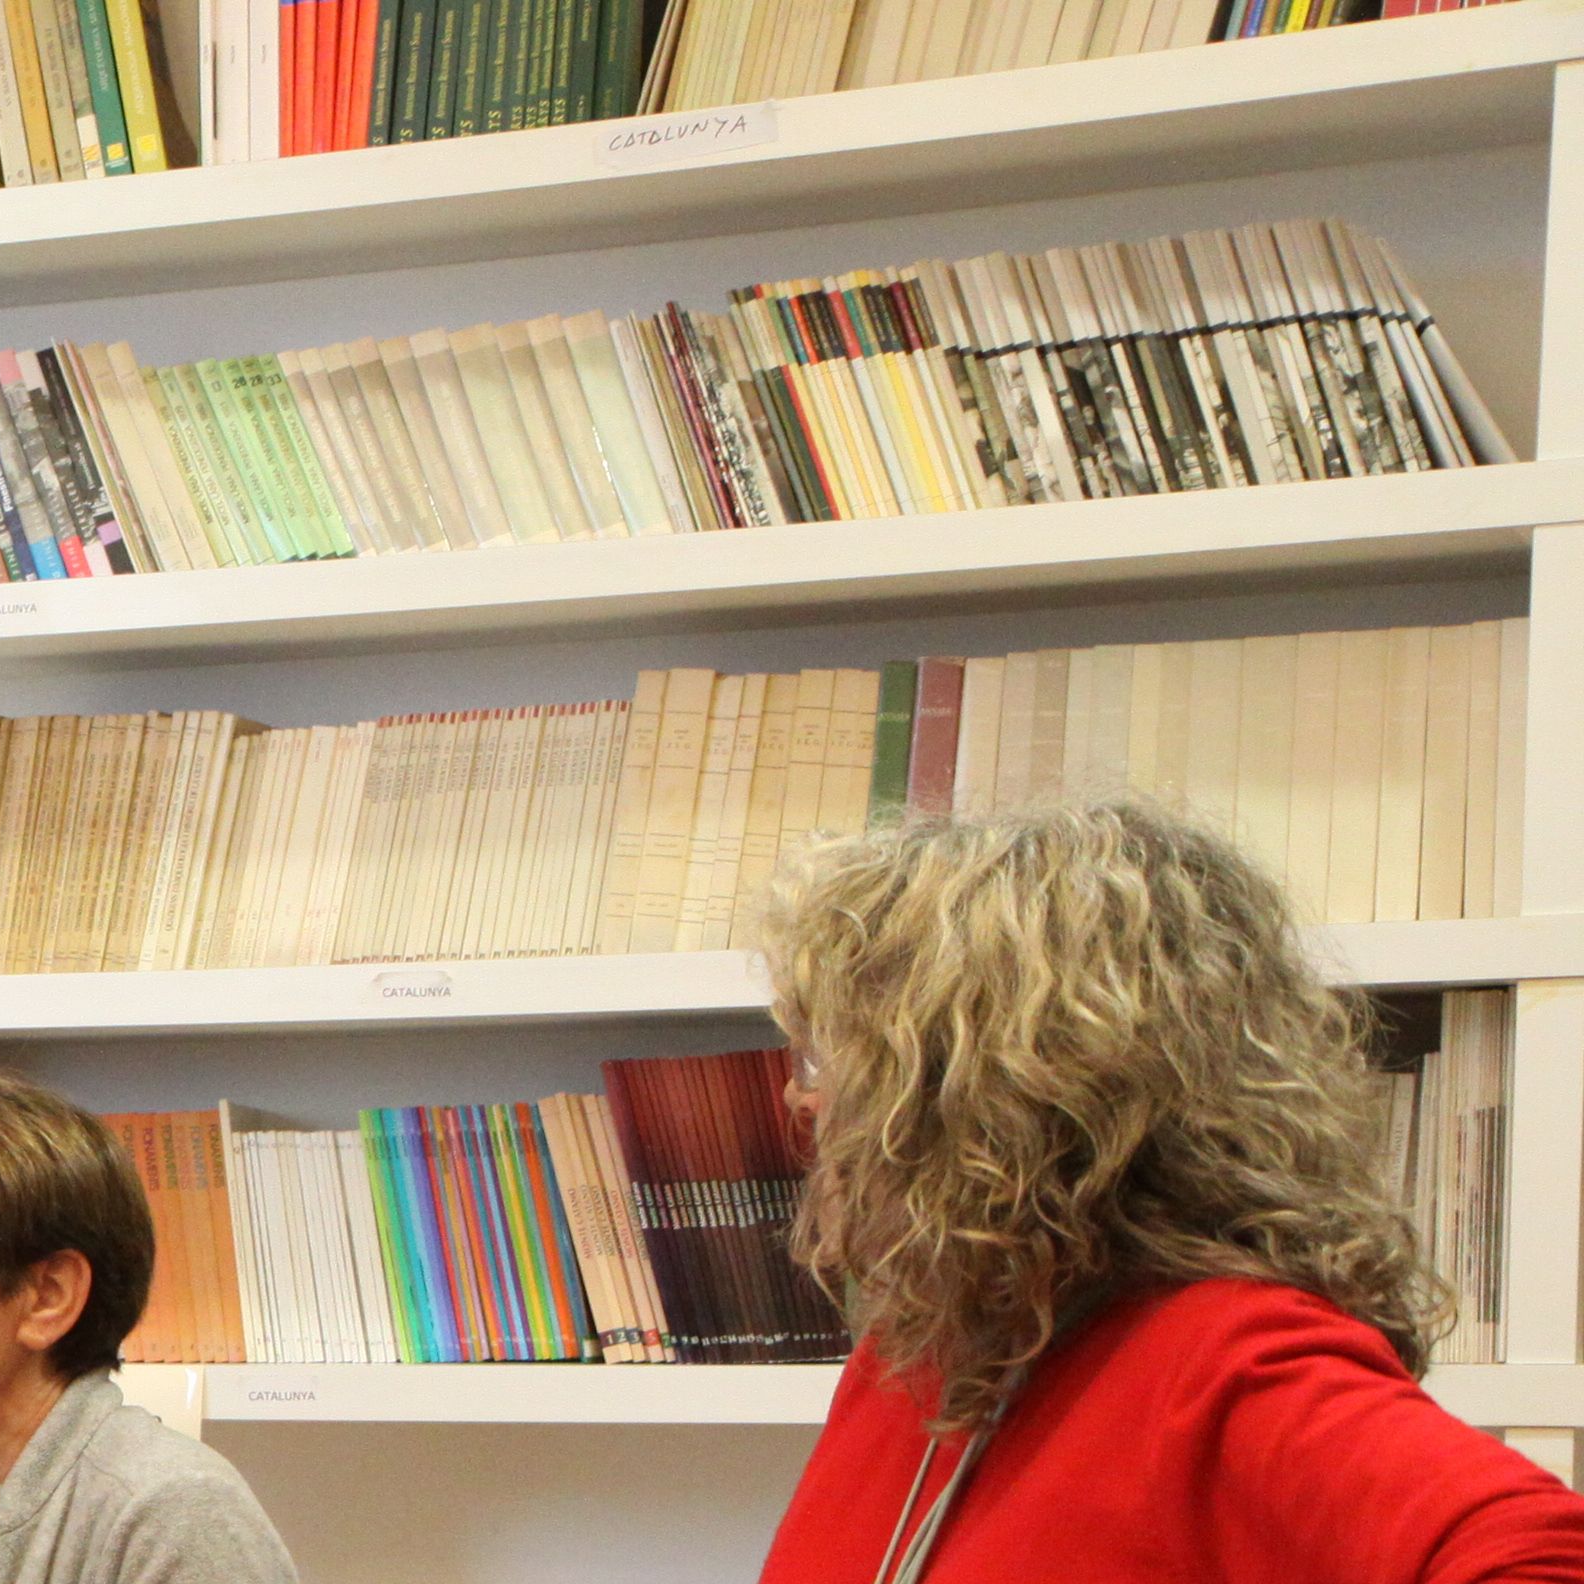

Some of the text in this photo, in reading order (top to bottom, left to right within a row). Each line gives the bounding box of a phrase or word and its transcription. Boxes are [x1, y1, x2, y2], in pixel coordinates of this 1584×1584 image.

[608, 116, 750, 152] CATALUNYA
[383, 986, 452, 998] CATALUNYA
[248, 1391, 316, 1401] CATALUNYA
